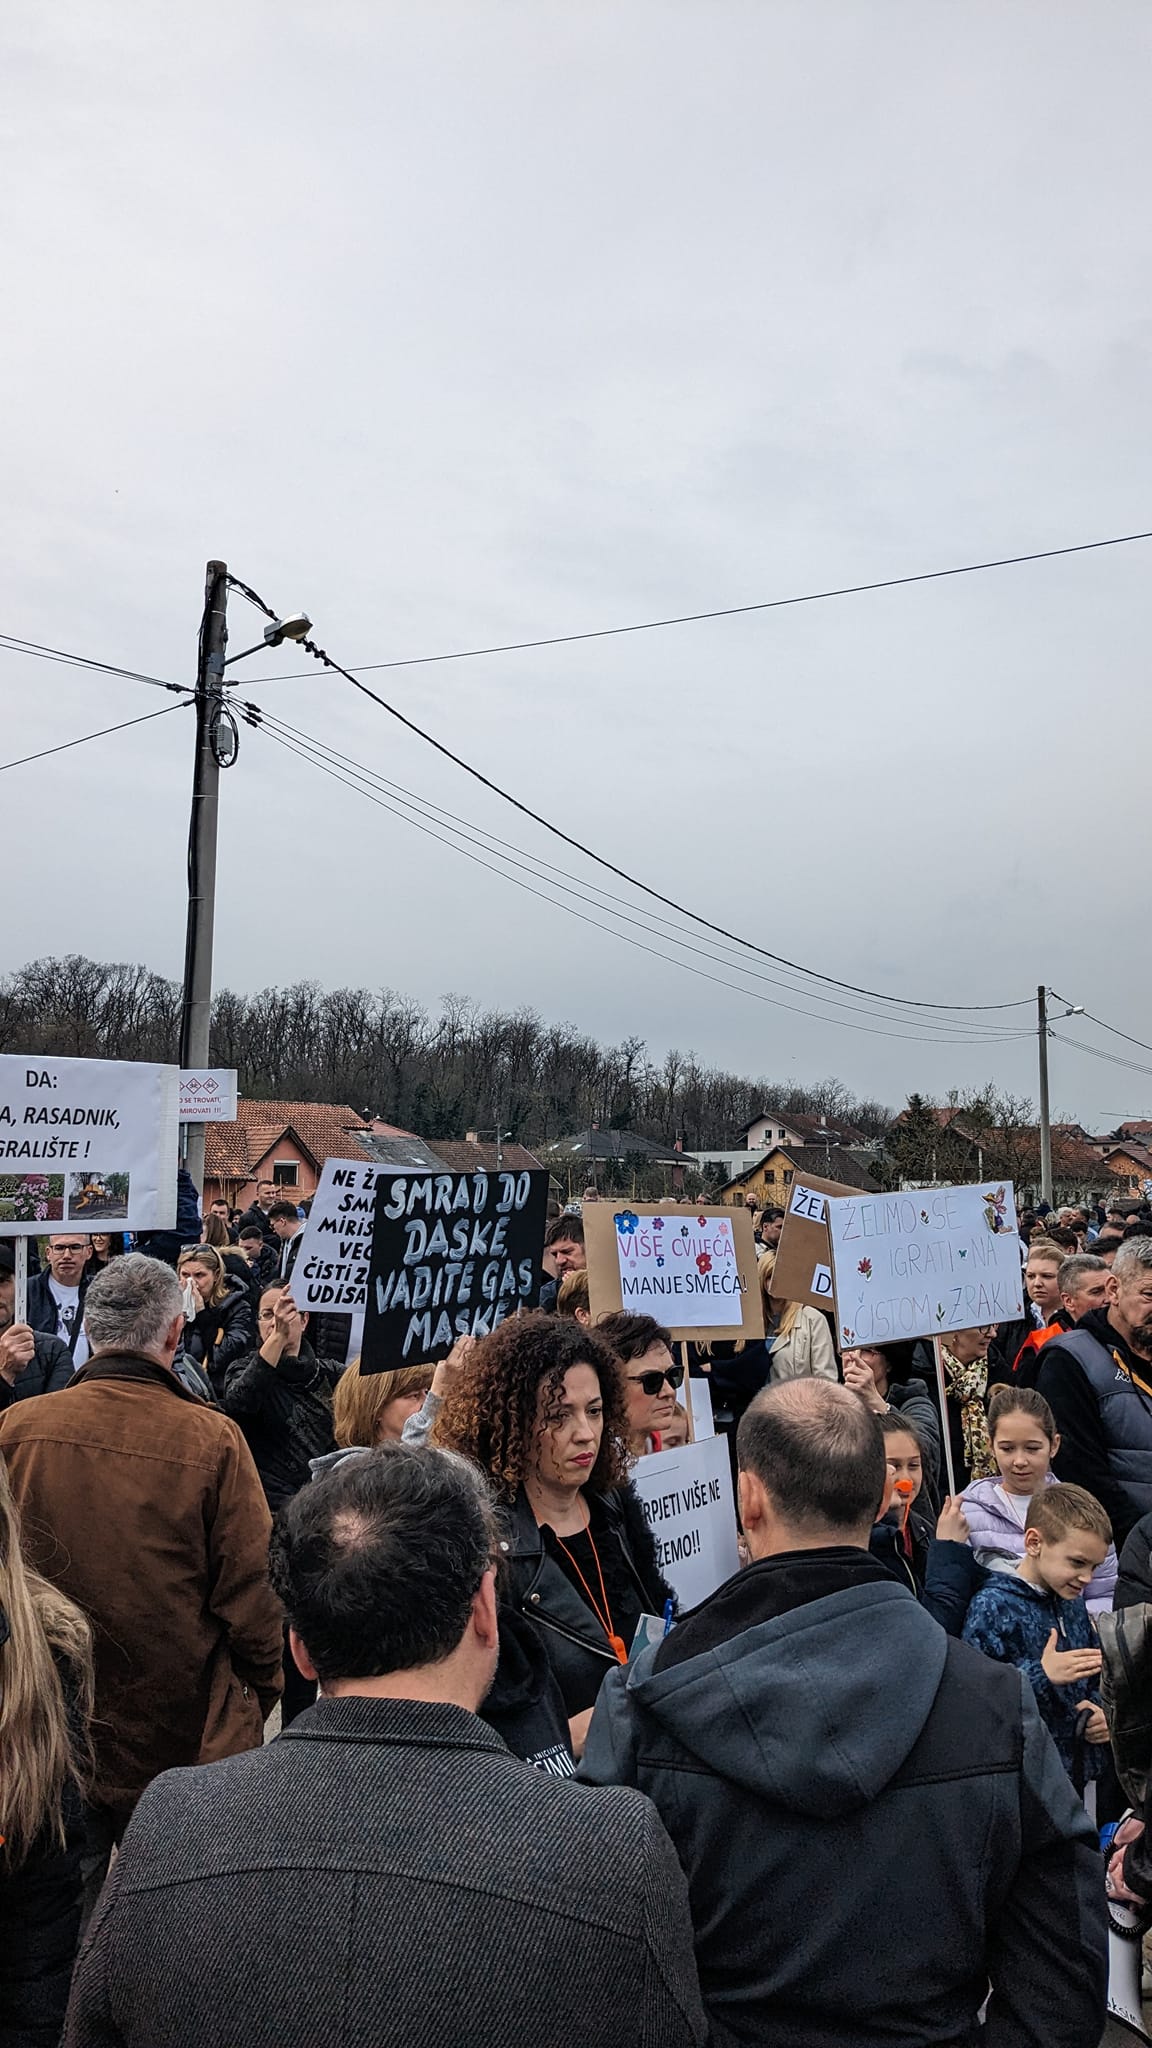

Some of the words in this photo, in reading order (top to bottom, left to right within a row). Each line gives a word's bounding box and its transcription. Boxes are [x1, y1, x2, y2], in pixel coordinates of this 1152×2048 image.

[26, 1070, 57, 1088] DA:
[23, 1106, 120, 1129] RASADNIK,
[84, 1141, 91, 1158] !
[332, 1169, 356, 1187] NE
[384, 1173, 488, 1220] SMRAD
[496, 1171, 531, 1213] DO
[839, 1199, 917, 1241] ŽELIMO
[931, 1195, 962, 1230] SE
[618, 1229, 665, 1258] VIŠE
[888, 1240, 954, 1279] IGRATI
[971, 1235, 999, 1268] NA
[376, 1261, 475, 1314] VADITE
[482, 1258, 533, 1301] GAS
[622, 1276, 683, 1295] MANJE
[685, 1270, 748, 1294] SMEĆA!
[854, 1291, 932, 1339] ČISTOM
[682, 1479, 708, 1511] VIŠE
[708, 1478, 721, 1503] NE
